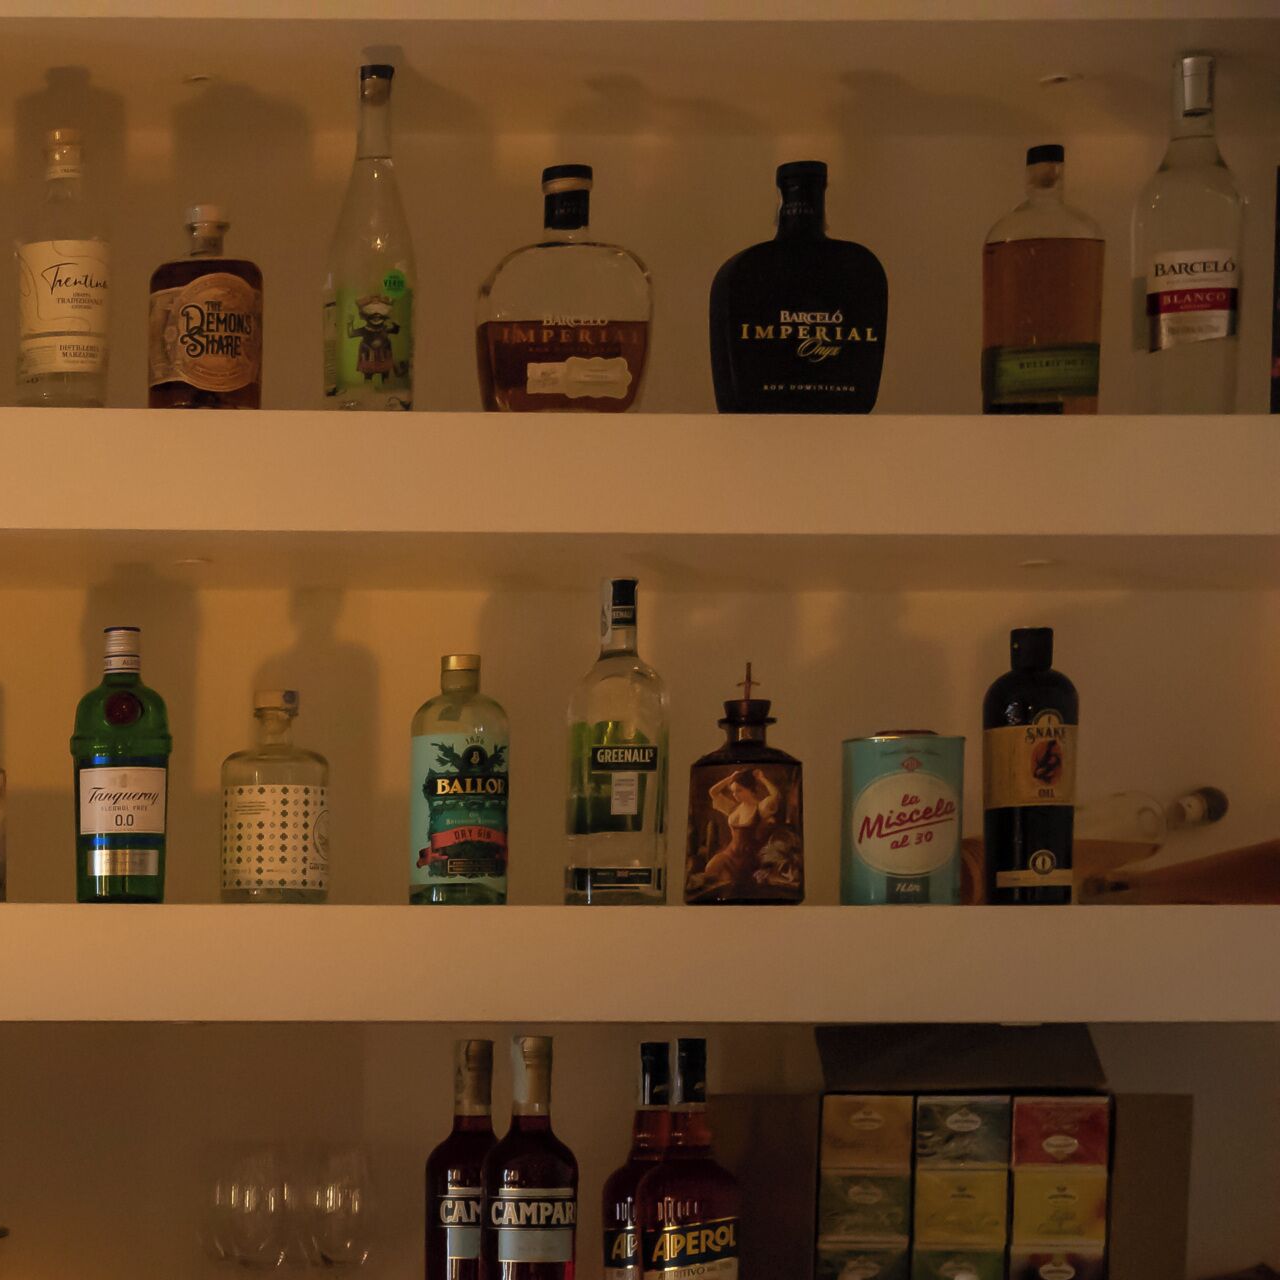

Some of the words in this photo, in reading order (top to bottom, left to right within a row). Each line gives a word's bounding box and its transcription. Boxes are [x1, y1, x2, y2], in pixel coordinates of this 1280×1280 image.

[1153, 257, 1236, 279] BARCELÓ
[41, 262, 110, 296] Trentino
[1162, 291, 1227, 306] BLANCO
[780, 308, 845, 324] BARCELÓ
[180, 326, 241, 359] SHARE
[741, 324, 878, 343] IMPERIAL
[797, 338, 843, 363] Onyx
[87, 786, 160, 805] Tanqueray
[436, 777, 507, 795] BALLOR
[901, 793, 921, 807] la
[114, 813, 135, 827] 0.0
[858, 798, 956, 844] Miscela
[454, 830, 473, 841] DRY
[890, 834, 909, 850] al
[915, 831, 934, 846] 30
[652, 1223, 738, 1263] APEROL
